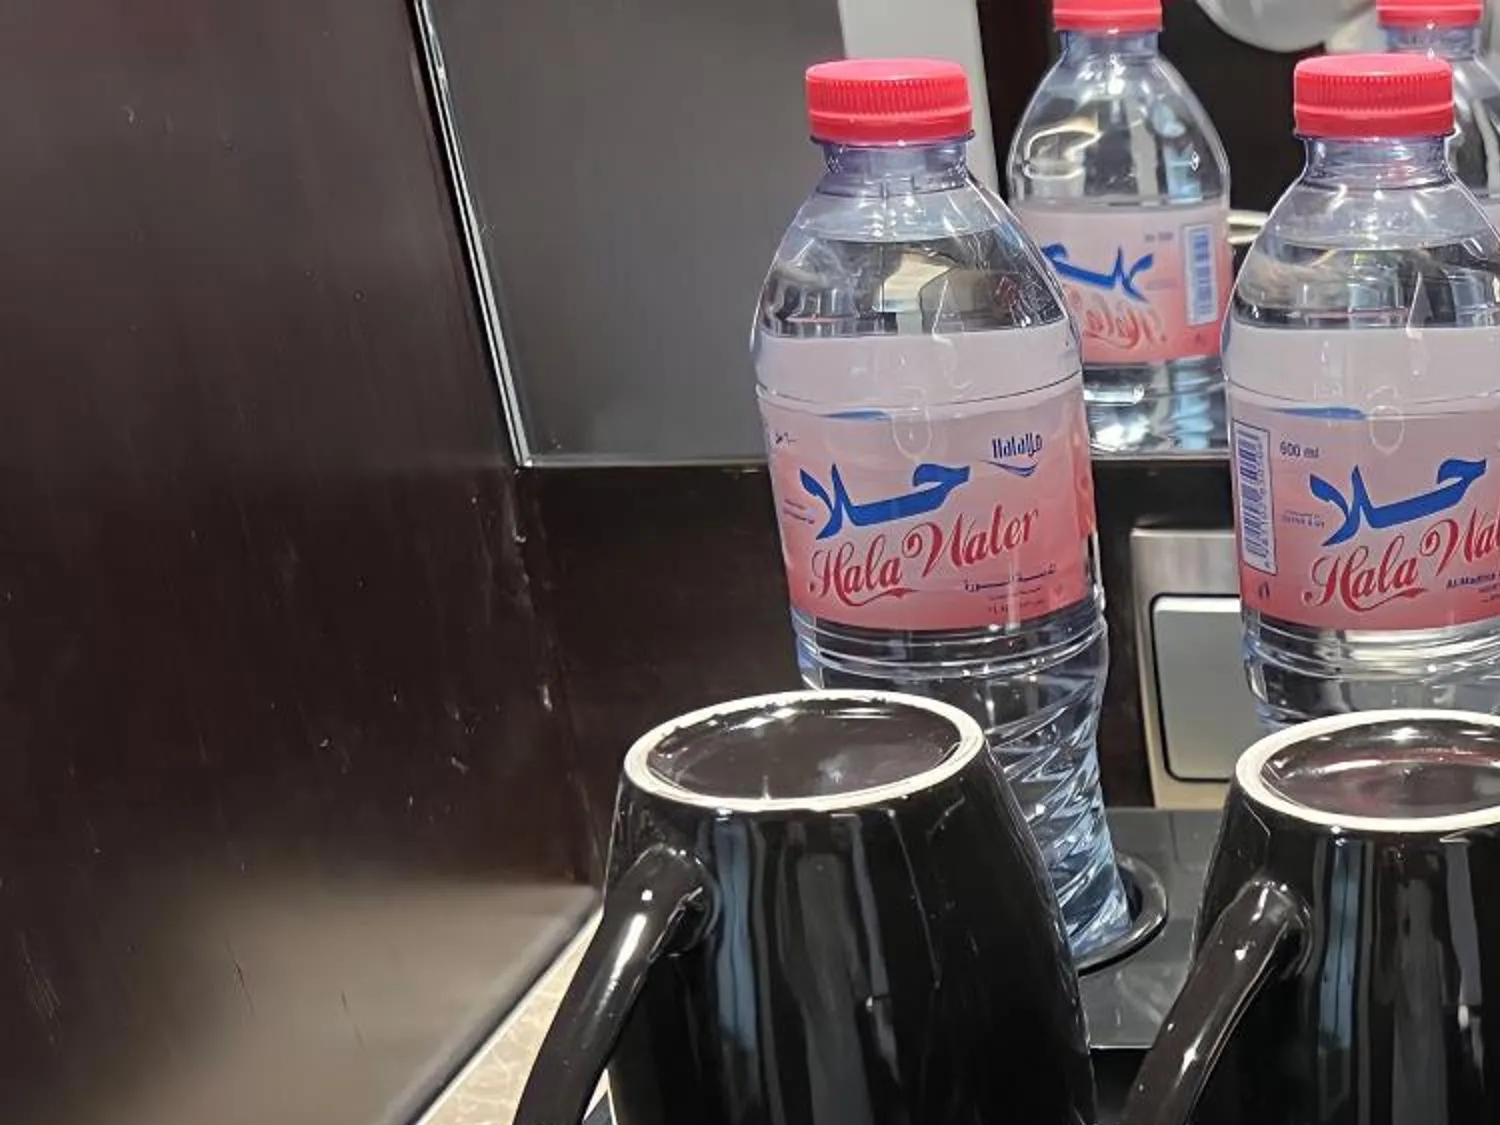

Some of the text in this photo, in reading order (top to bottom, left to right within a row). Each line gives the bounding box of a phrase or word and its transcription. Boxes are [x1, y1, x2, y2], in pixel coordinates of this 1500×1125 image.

[809, 504, 1039, 607] Hala Water
[1302, 535, 1427, 612] Hala
